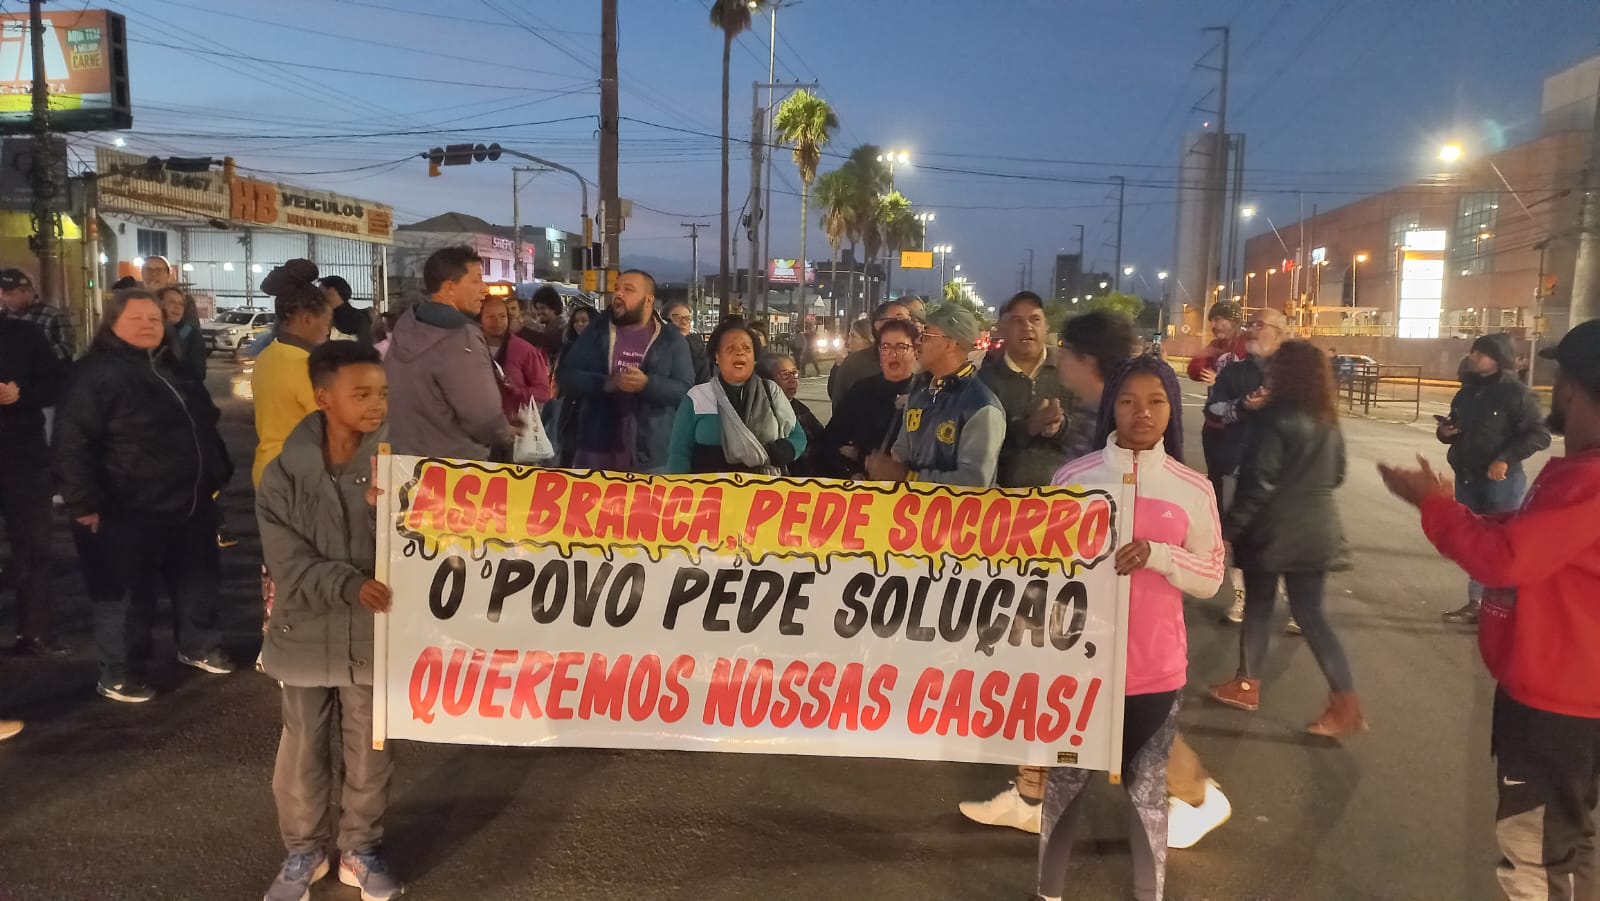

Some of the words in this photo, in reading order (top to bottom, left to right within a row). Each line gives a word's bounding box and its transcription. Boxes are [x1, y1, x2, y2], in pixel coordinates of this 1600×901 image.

[230, 181, 278, 223] HB
[281, 192, 364, 218] VEICULOS
[287, 213, 359, 234] MULTIMARCAS
[407, 465, 508, 534] ASA
[525, 472, 737, 550] BRANCA,
[743, 489, 874, 550] PEDE
[888, 494, 1109, 560] SOCORRO
[429, 555, 466, 620] O
[486, 558, 646, 628] POVO
[662, 567, 816, 636] PEDE
[834, 568, 1096, 659] SOLUÇÃO,
[408, 646, 696, 724] QUEREMOS
[702, 657, 898, 734] NOSSAS
[906, 667, 1102, 747] CASAS!
